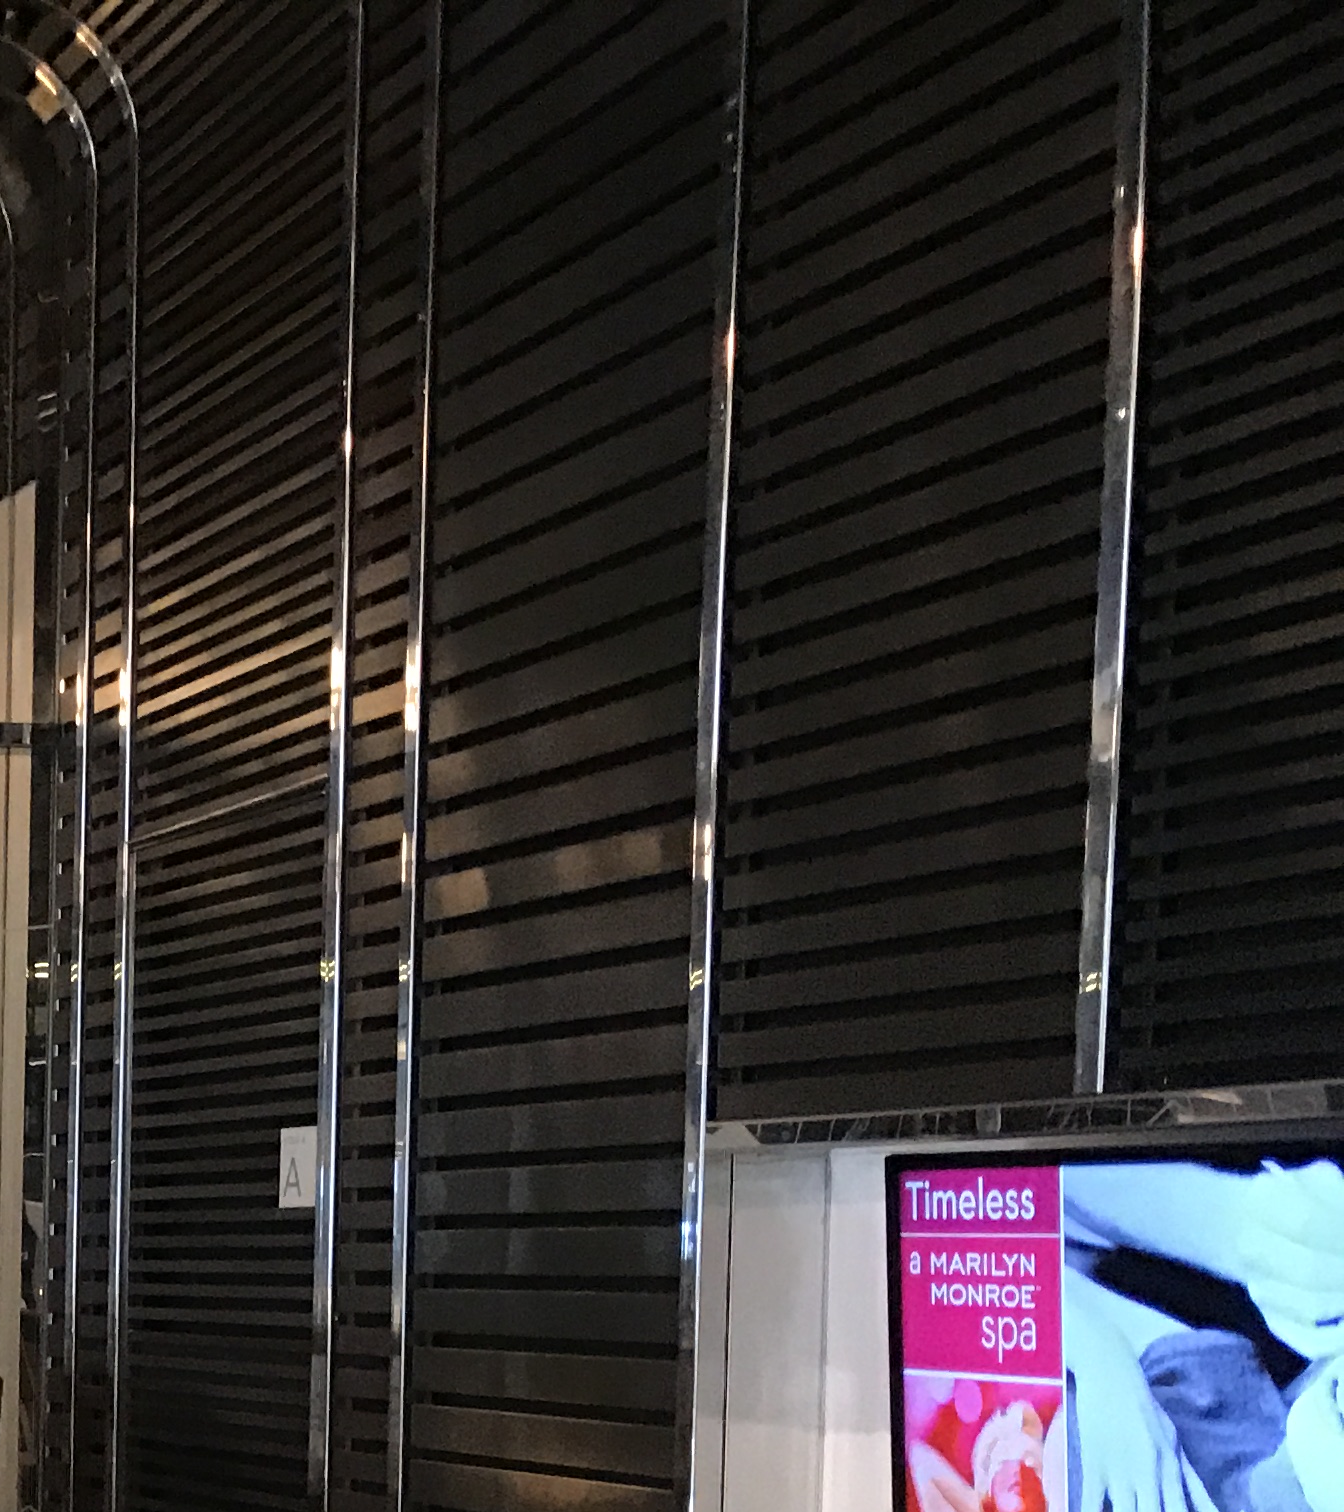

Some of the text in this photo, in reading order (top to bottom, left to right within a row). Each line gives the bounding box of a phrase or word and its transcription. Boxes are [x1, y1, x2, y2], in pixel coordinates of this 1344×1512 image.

[904, 1175, 1036, 1222] Timeless
[909, 1251, 1036, 1277] a MARILYN
[930, 1282, 1036, 1309] MONROE
[980, 1315, 1037, 1364] spa
